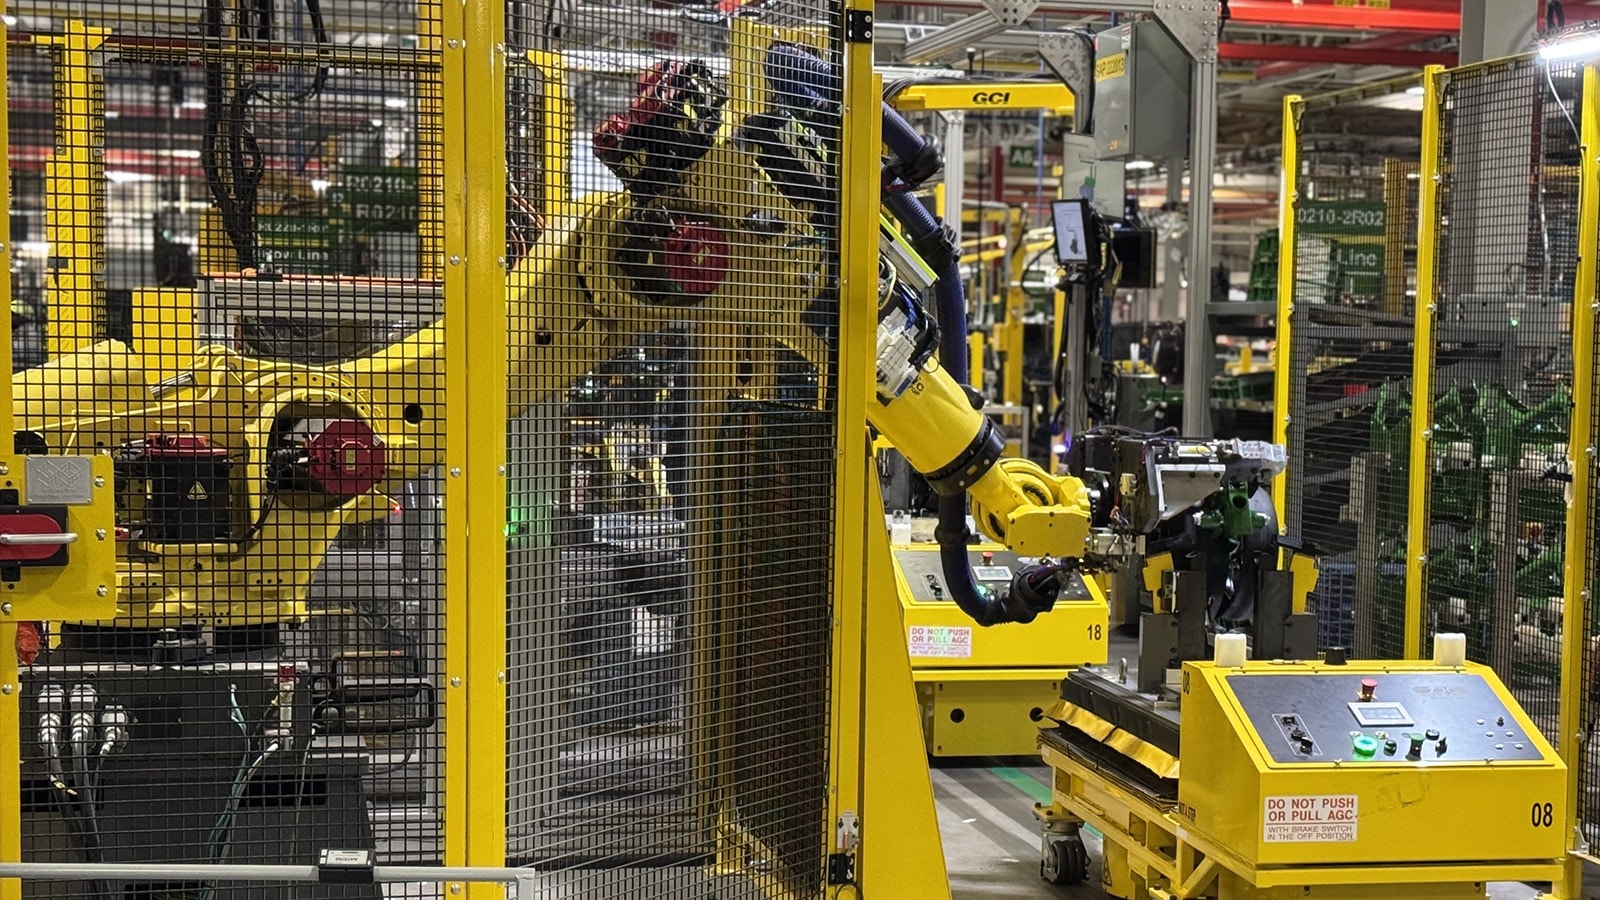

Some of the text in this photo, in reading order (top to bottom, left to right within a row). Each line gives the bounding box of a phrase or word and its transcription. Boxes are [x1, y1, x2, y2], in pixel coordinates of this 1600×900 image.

[972, 92, 1010, 104] GCI
[1012, 150, 1033, 164] A6
[1336, 248, 1378, 266] Line
[1087, 624, 1102, 640] 18
[1268, 798, 1354, 809] DO NOT PUSH
[1268, 810, 1353, 821] OR PULL AGC
[1532, 802, 1553, 827] 08
